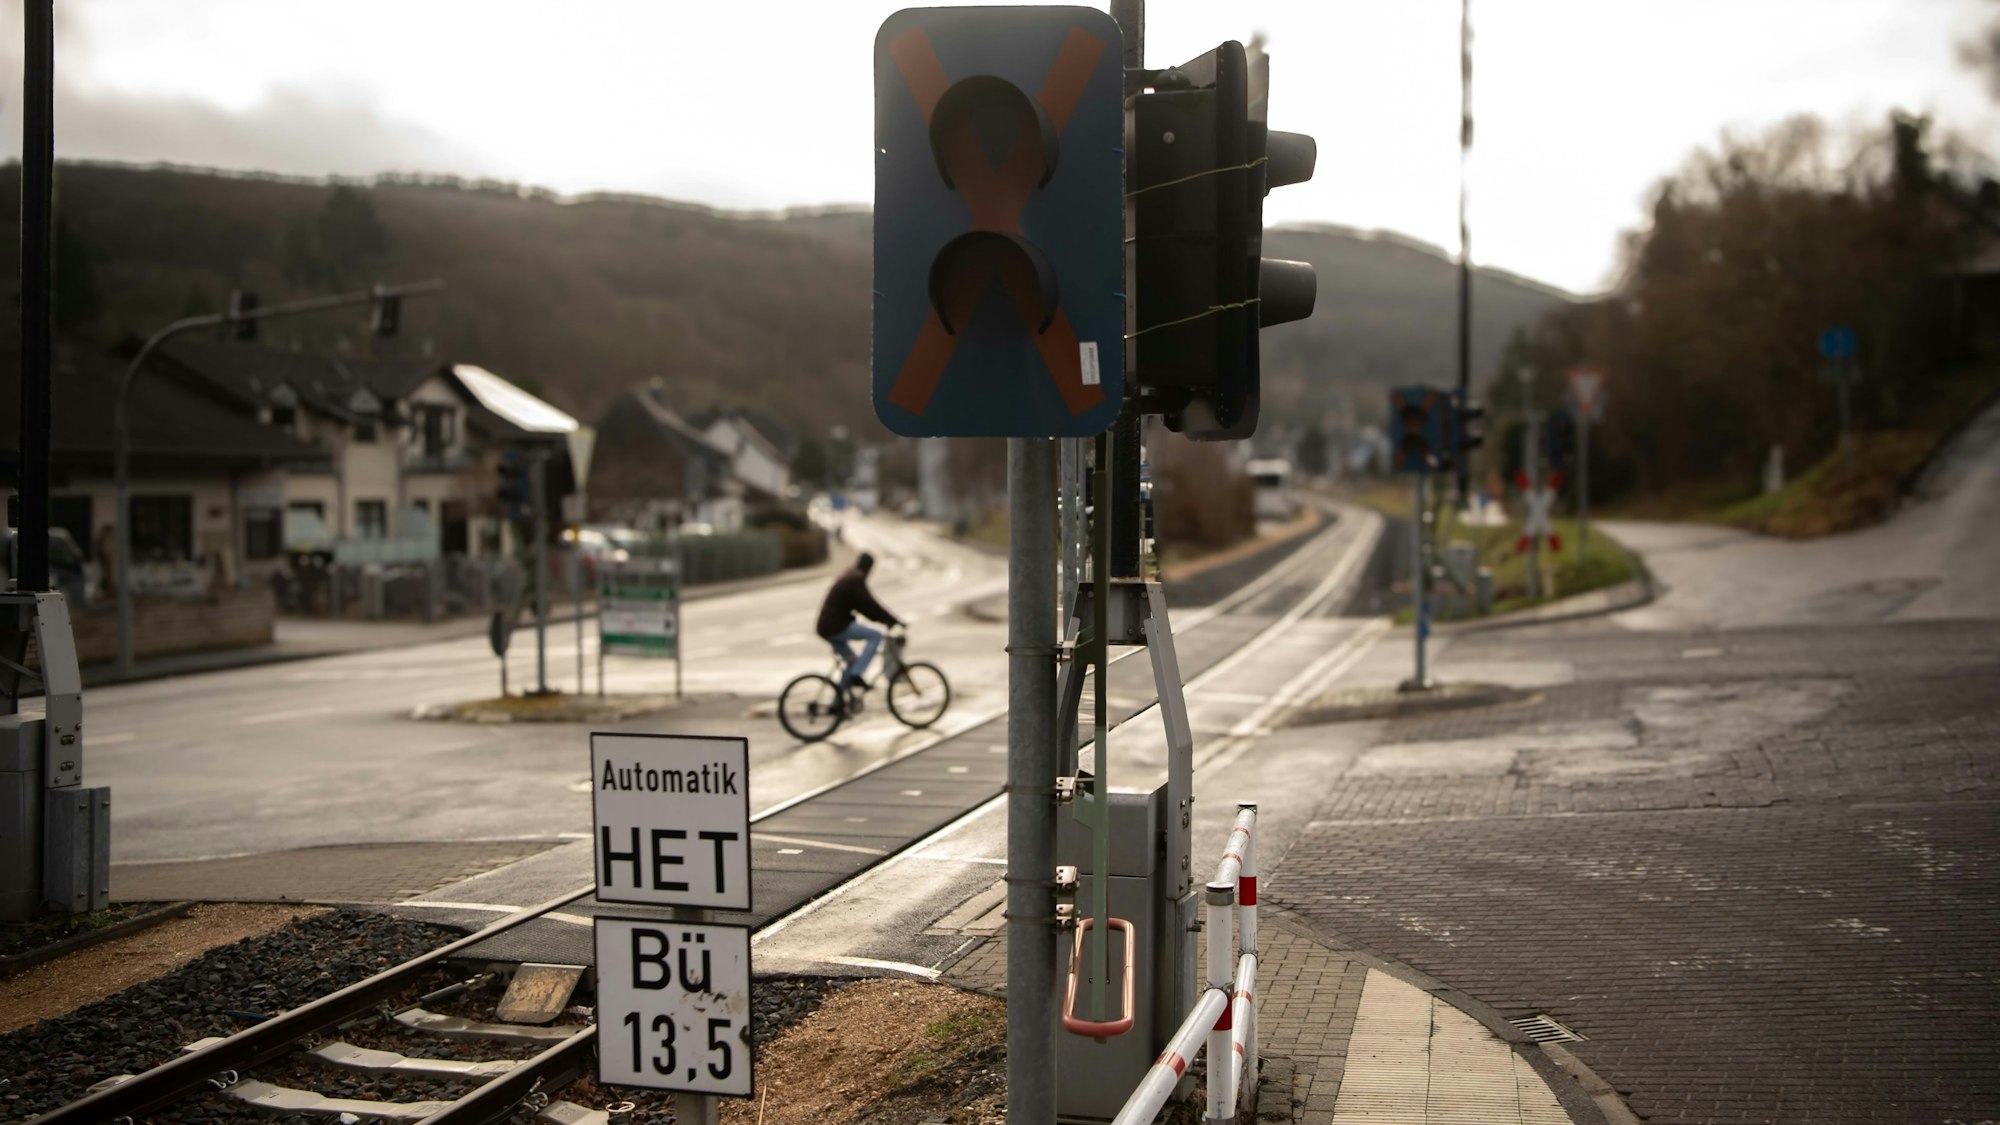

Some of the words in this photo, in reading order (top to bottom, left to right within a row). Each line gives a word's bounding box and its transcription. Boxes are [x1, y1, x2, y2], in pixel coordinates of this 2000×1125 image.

[602, 759, 739, 795] Automatik
[601, 825, 739, 894] HET
[631, 927, 712, 994] Bü
[623, 1011, 732, 1083] 13,5
